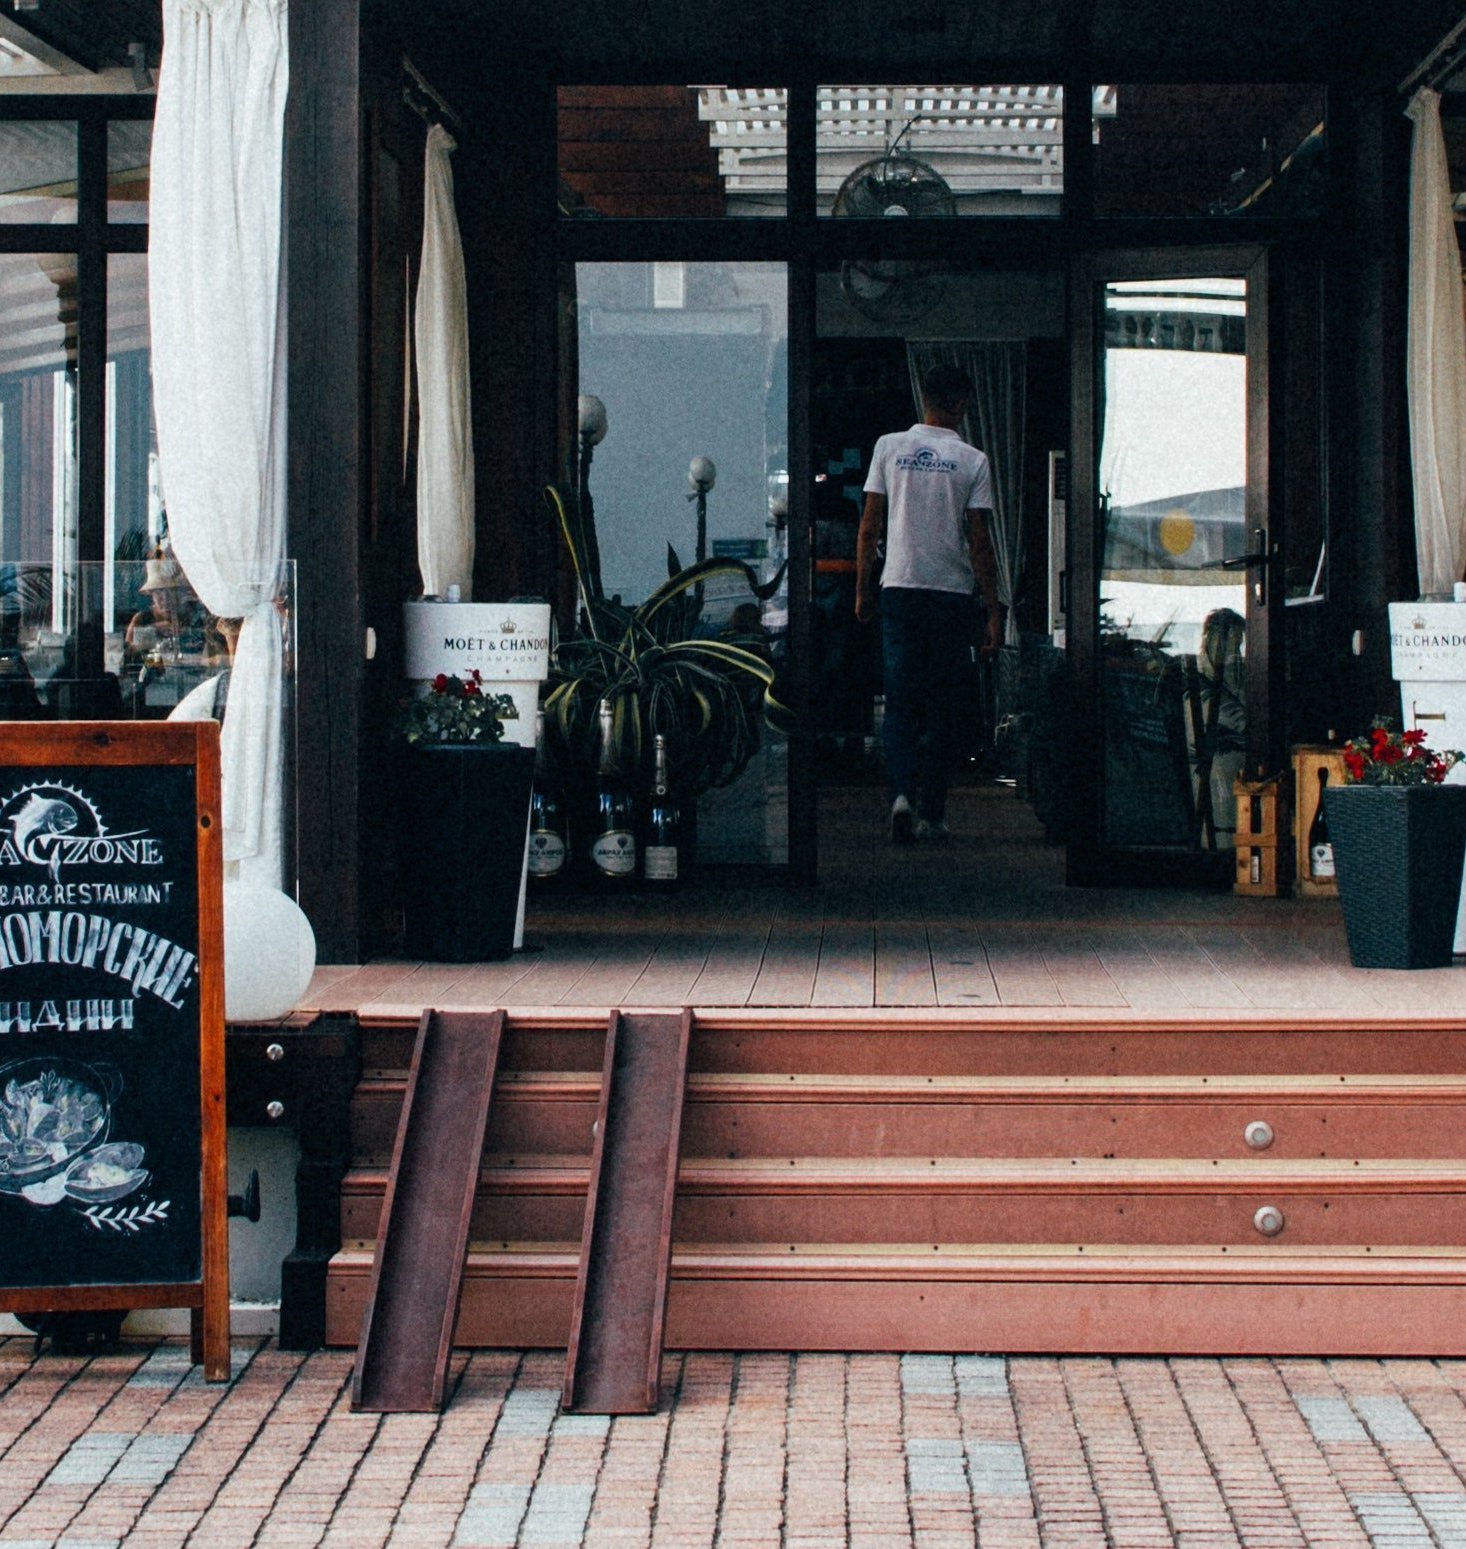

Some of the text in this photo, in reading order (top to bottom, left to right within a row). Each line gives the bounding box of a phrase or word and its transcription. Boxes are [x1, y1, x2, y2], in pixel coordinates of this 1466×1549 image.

[444, 637, 485, 650] MOËT
[488, 642, 496, 651] &
[63, 838, 164, 865] ZONE
